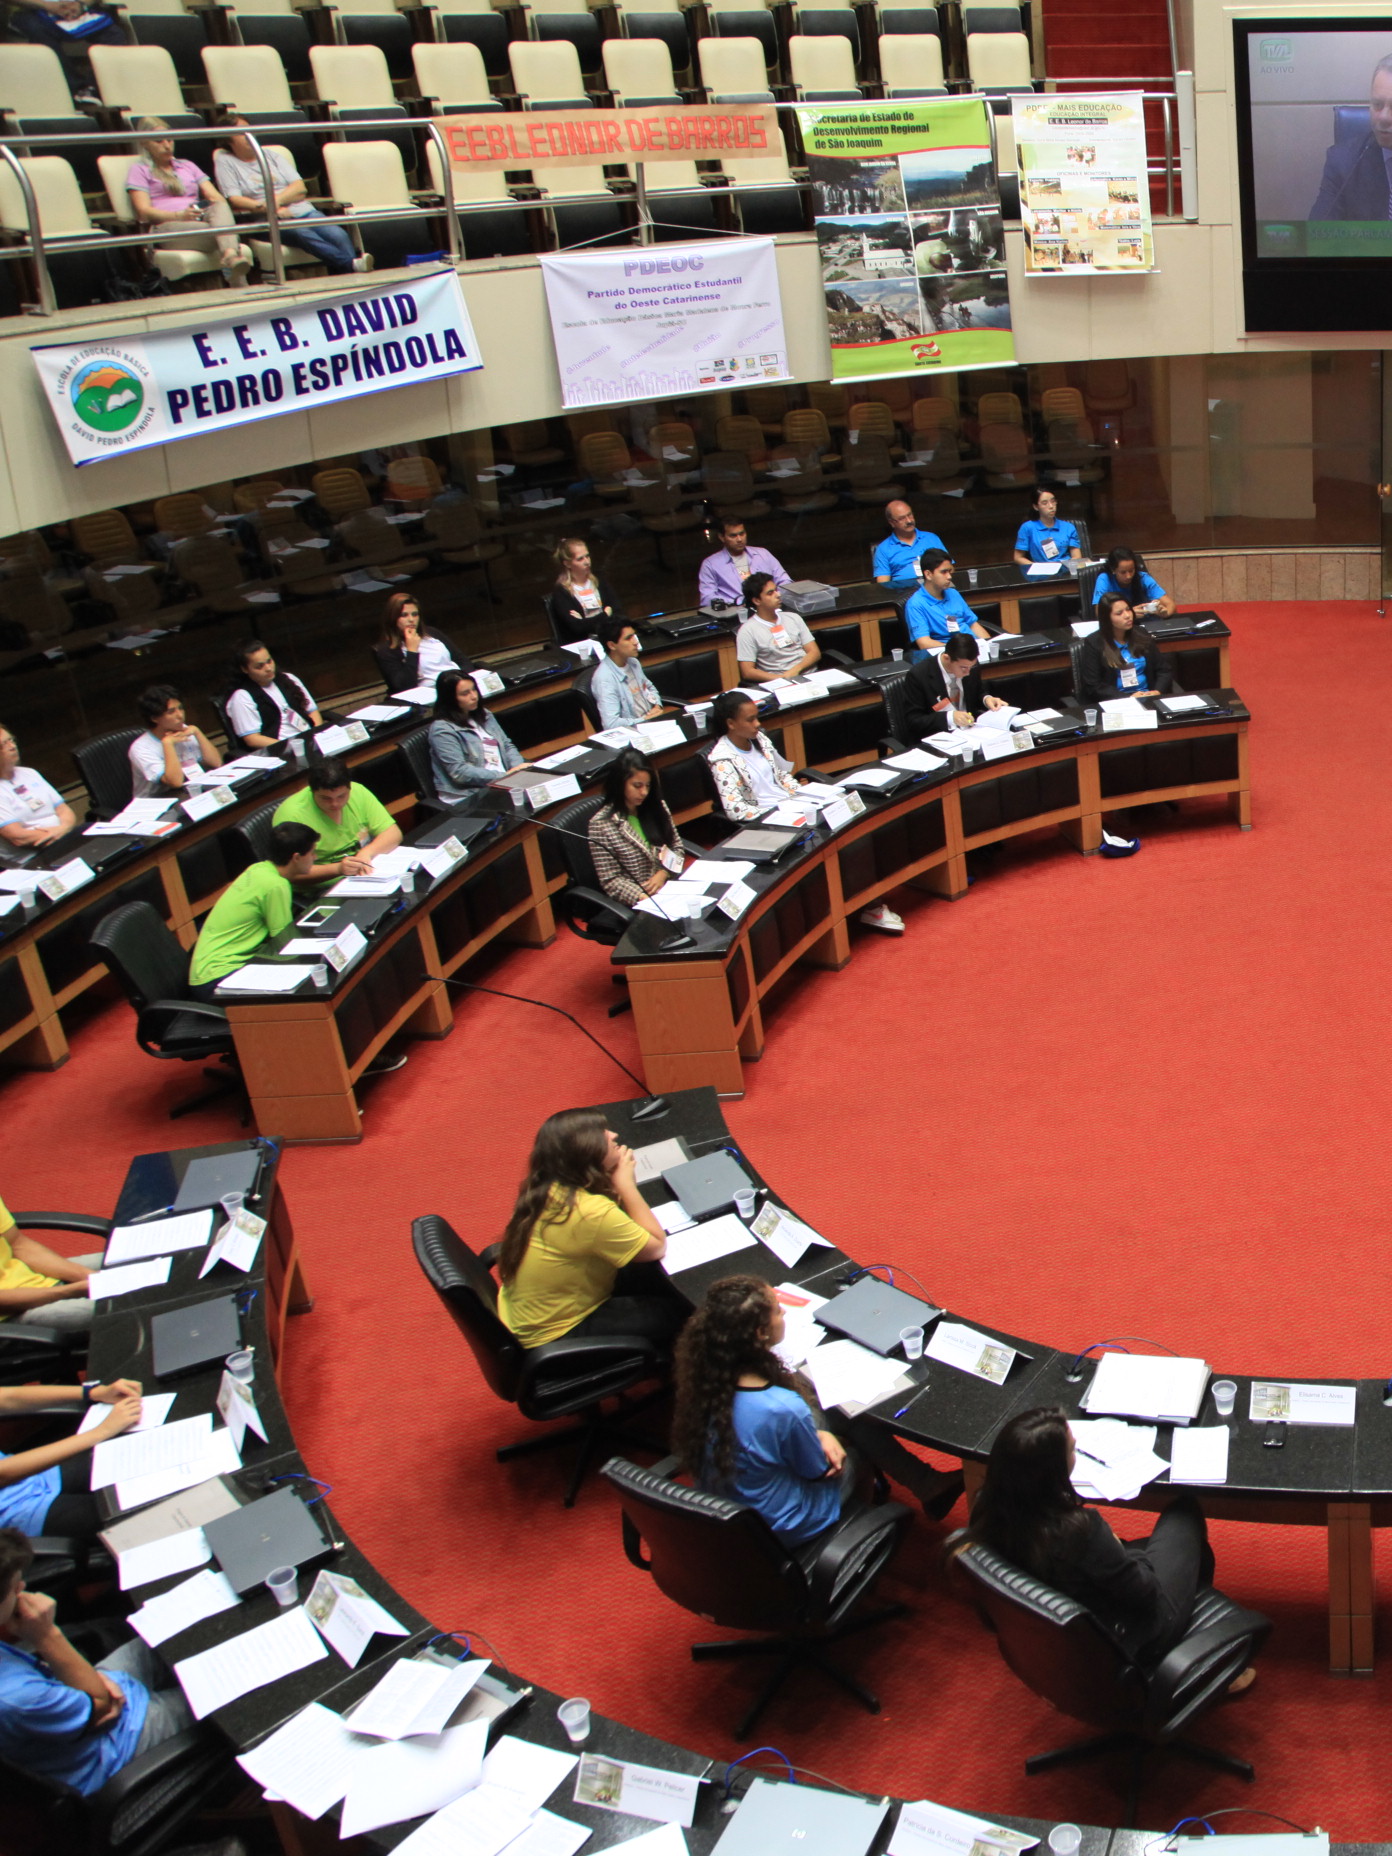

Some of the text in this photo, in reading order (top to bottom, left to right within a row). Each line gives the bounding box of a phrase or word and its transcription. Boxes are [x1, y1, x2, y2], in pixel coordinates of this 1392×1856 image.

[1260, 66, 1294, 74] AO VIVO
[812, 111, 914, 124] ecretaria de Estado de
[1078, 103, 1123, 114] EDUCAÇÃO
[508, 118, 625, 160] LEONOR
[625, 116, 664, 153] DE
[665, 114, 768, 151] BARROS
[813, 123, 930, 137] Desenvolvimento Regional
[815, 137, 884, 151] de São Joaquim
[623, 253, 705, 277] PDEOC
[587, 276, 743, 299] Partido Democrático Estudantil
[614, 291, 721, 310] do Oeste Catarinense
[192, 293, 419, 369] E. E. B. DAVID
[57, 364, 73, 395] ESCOLA
[71, 356, 81, 366] DE
[80, 347, 121, 360] EDUCAÇÃO
[167, 328, 467, 424] PEDRO ESPÍNDOLA
[71, 422, 95, 442] DAVID
[97, 436, 124, 446] PEDRO
